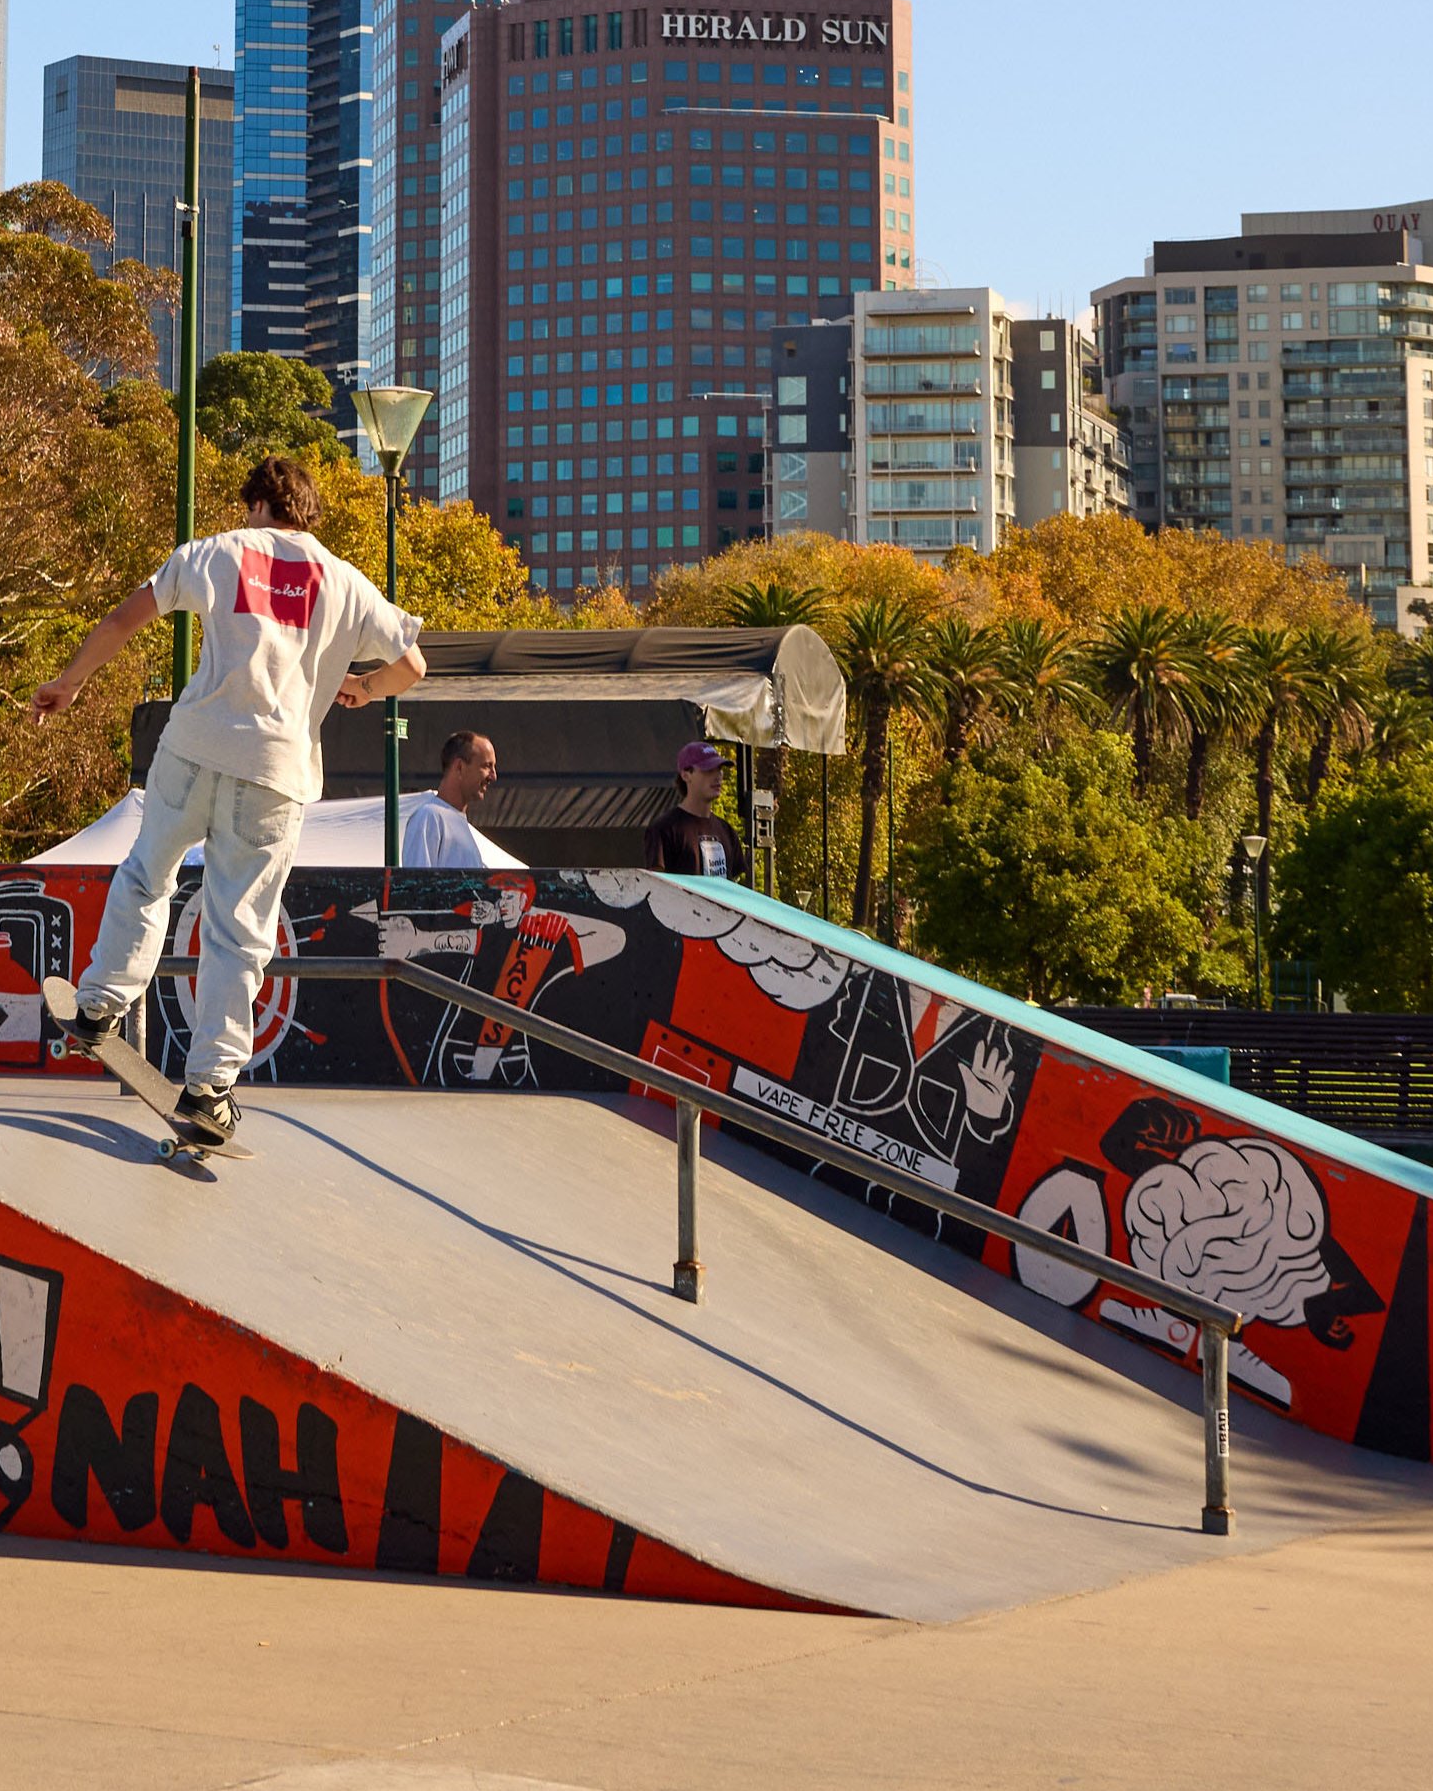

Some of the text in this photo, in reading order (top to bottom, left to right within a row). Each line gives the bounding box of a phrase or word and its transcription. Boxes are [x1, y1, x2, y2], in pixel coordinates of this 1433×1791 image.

[661, 13, 890, 46] HERALD SUN
[1373, 212, 1421, 233] QUAY
[483, 940, 534, 1044] FACS
[758, 1081, 927, 1174] VAPE FREE ZONE
[51, 1382, 349, 1554] NAH
